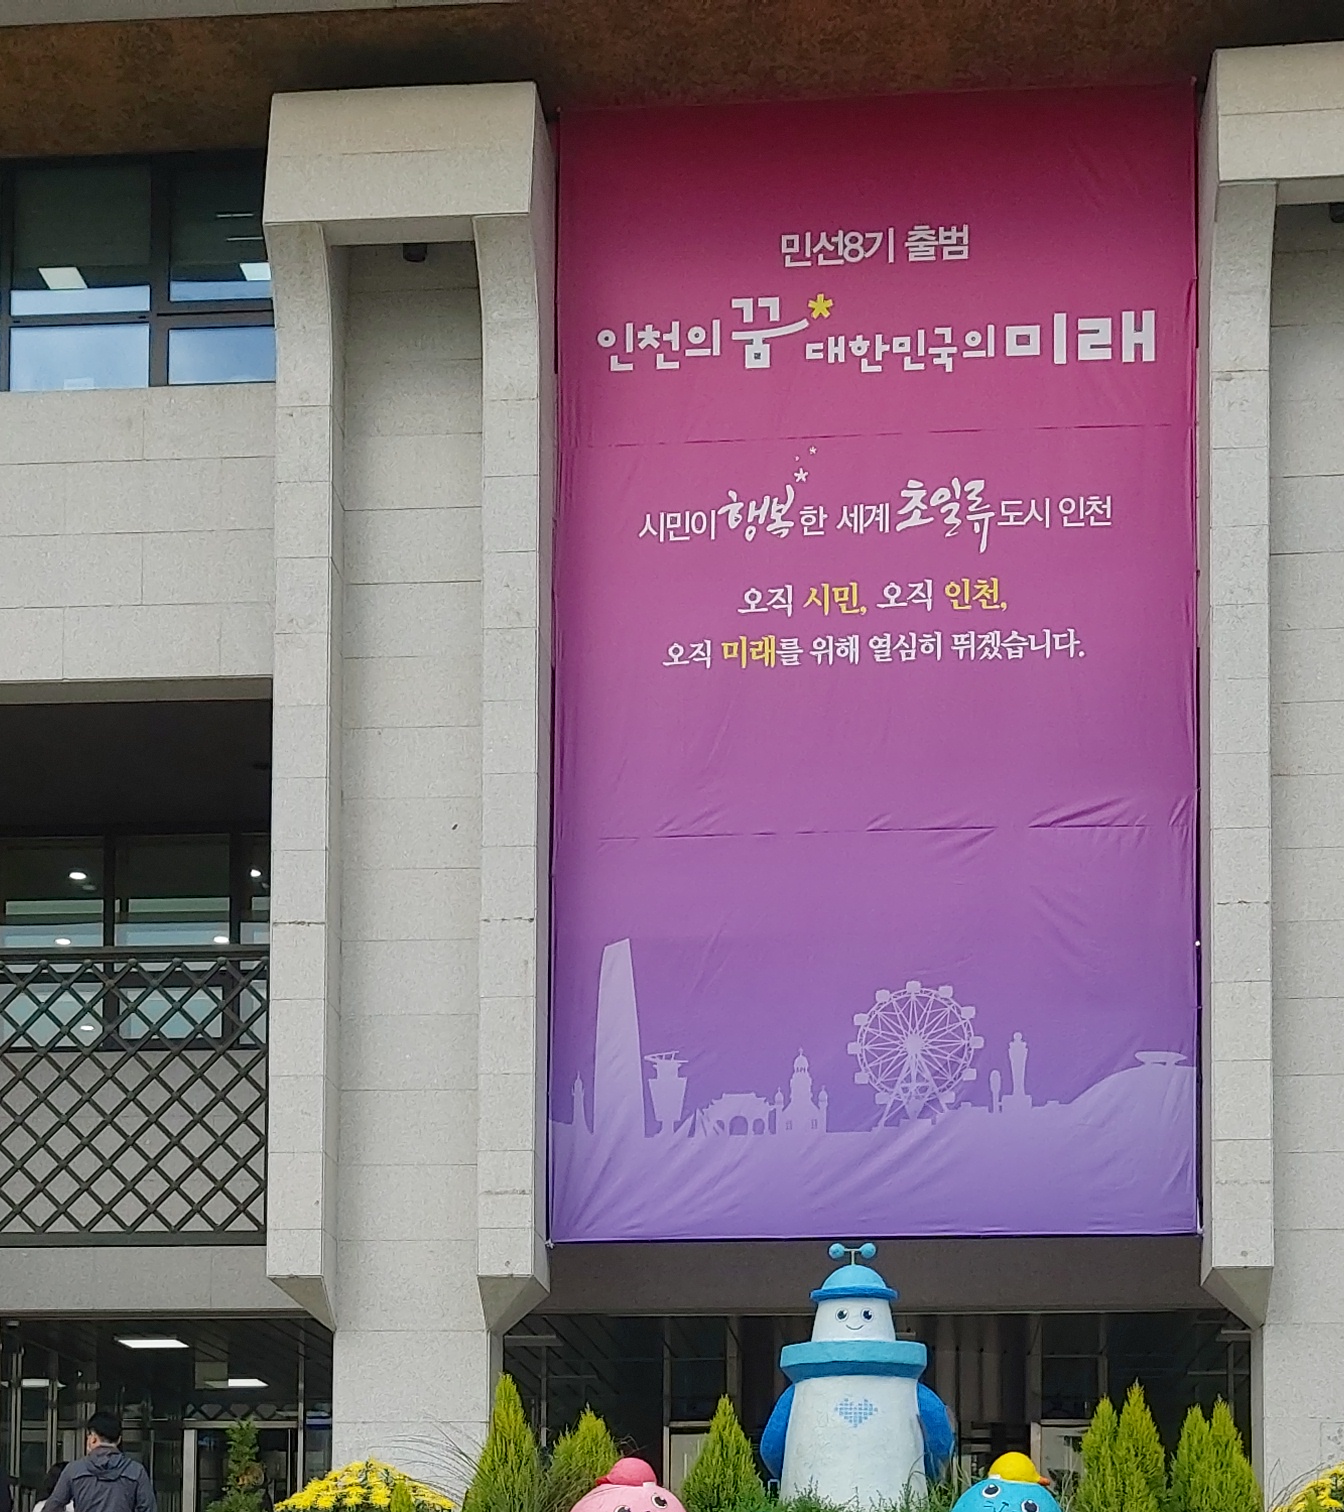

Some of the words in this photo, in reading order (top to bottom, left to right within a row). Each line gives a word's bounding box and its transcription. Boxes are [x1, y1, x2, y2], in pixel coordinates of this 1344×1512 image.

[781, 229, 895, 267] 민선8기
[904, 225, 970, 262] 출범
[597, 321, 720, 371] 인천의
[731, 296, 808, 369] 꿈
[806, 323, 995, 373] 대한민국의
[1005, 310, 1155, 364] 미래
[638, 506, 716, 543] 시민이
[836, 502, 890, 534] 세계
[1058, 495, 1113, 529] 인천
[737, 587, 793, 616] 오직
[803, 583, 867, 616] 시민,
[876, 581, 933, 613] 오직
[944, 578, 1007, 612] 인천,
[662, 640, 711, 669] 오직
[722, 635, 804, 668] 미래를
[809, 635, 860, 666] 위해
[868, 633, 942, 663] 열심히
[950, 628, 1085, 660] 뛰겠습니다.
